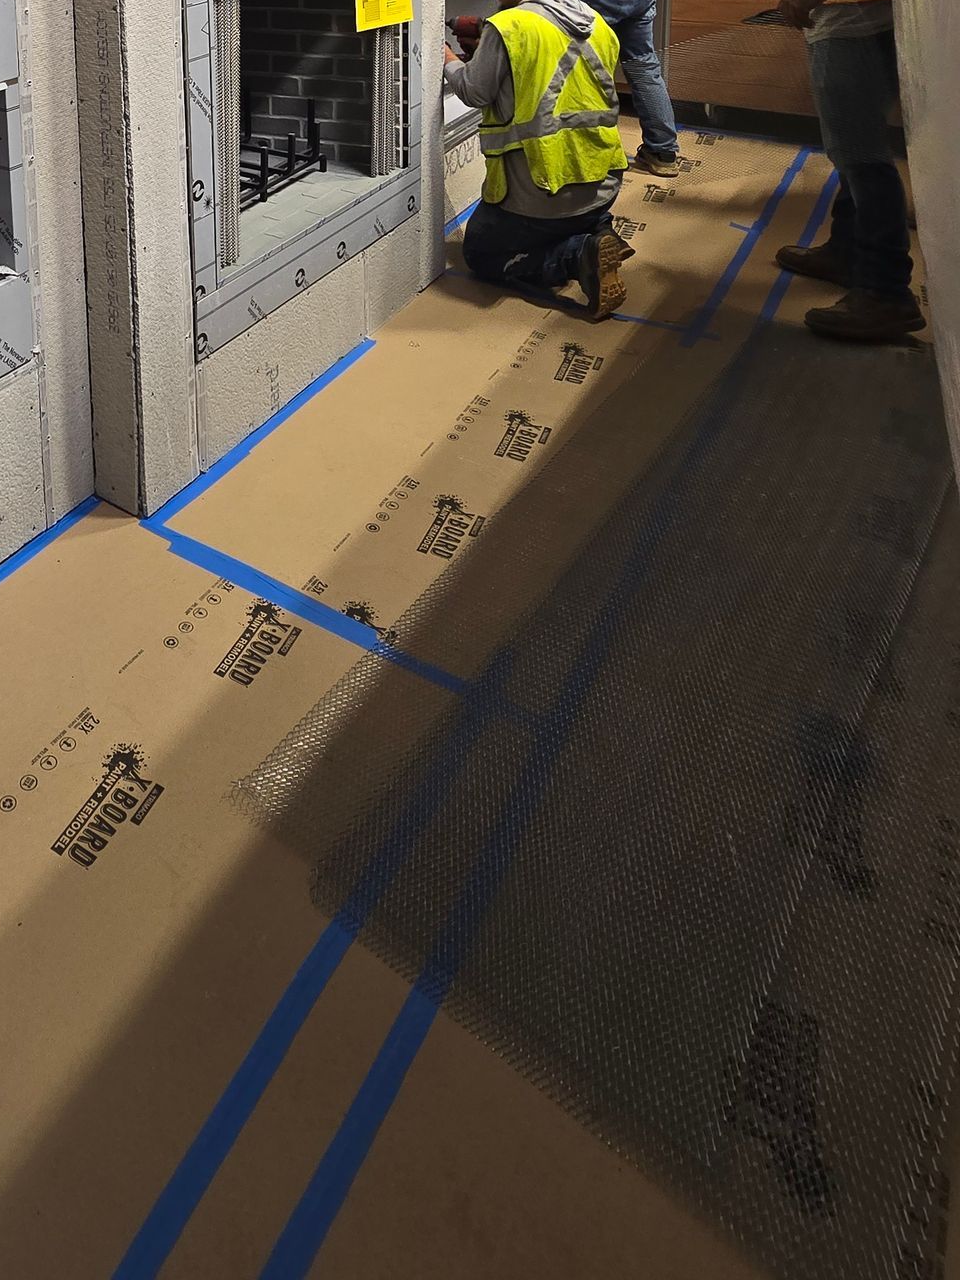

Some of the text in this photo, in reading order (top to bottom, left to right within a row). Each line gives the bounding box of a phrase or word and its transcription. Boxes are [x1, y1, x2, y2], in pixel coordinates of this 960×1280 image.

[2, 341, 26, 362] The Novacel
[216, 611, 268, 673] PAINT REMODEL
[78, 714, 100, 736] 2.5X
[102, 761, 127, 792] PAINT
[54, 798, 99, 849] REMODEL
